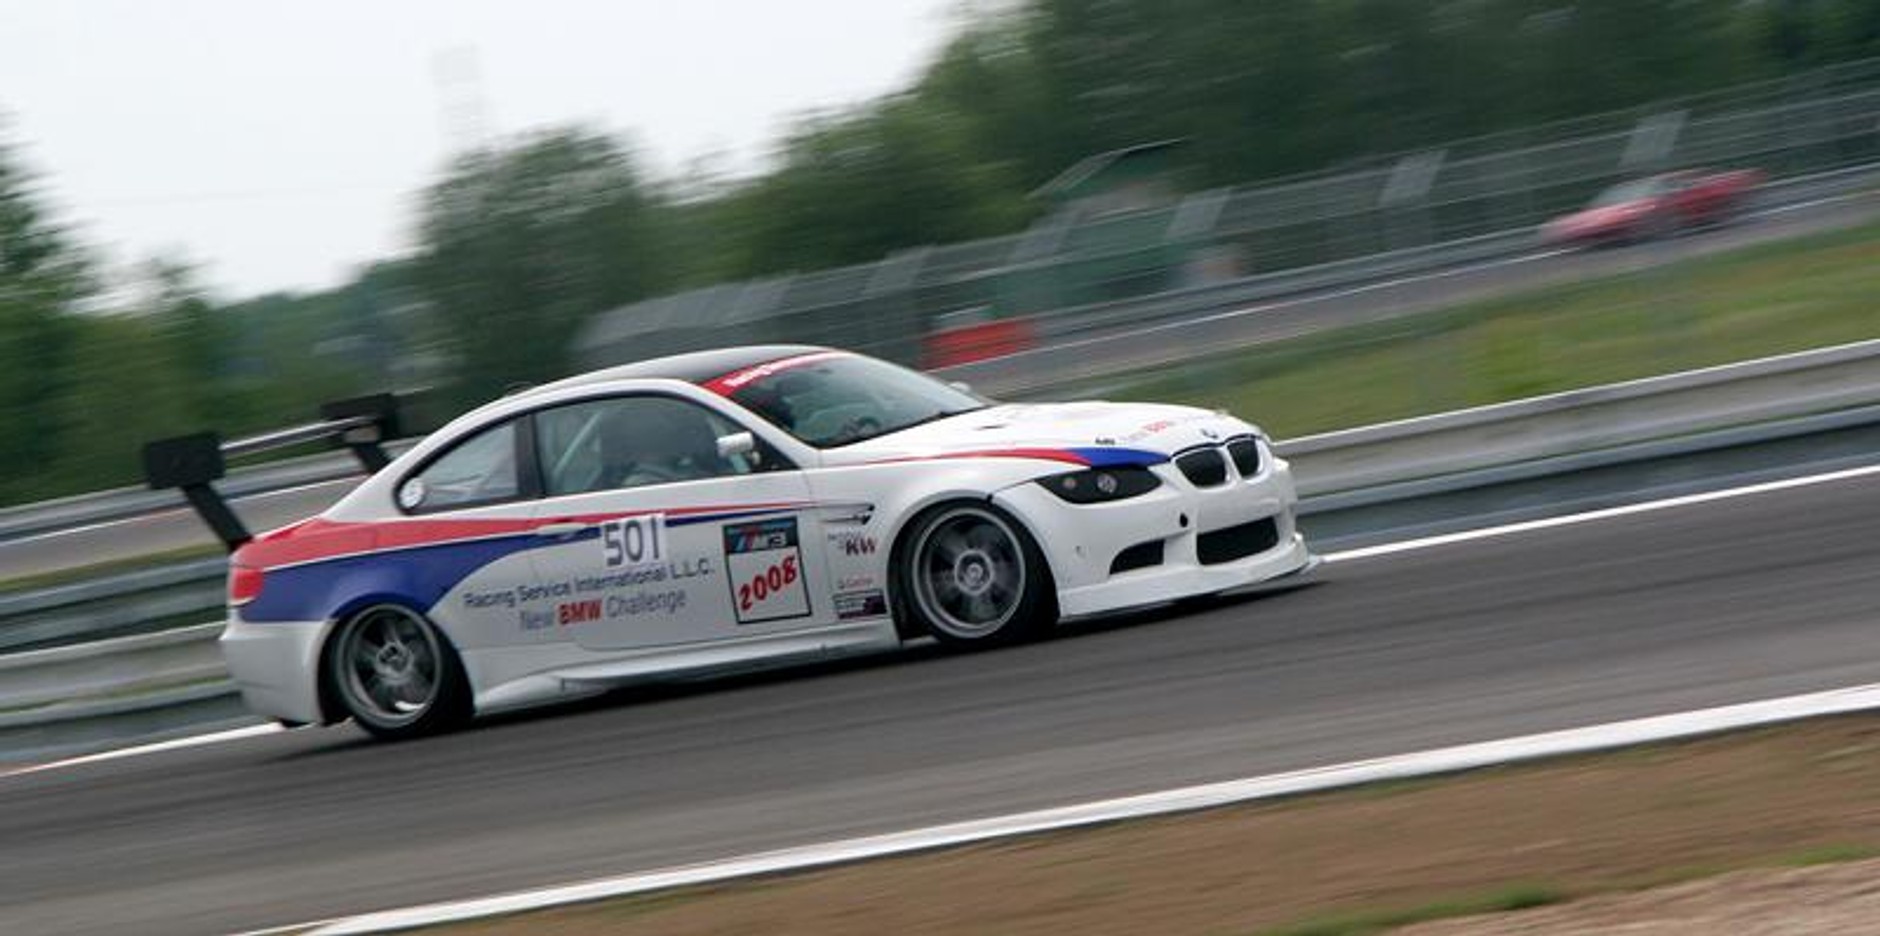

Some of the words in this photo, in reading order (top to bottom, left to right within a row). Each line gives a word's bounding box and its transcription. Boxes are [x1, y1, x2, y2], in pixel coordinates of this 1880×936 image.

[604, 517, 660, 567] 501
[846, 537, 875, 556] KW
[463, 590, 516, 608] Racing
[517, 583, 571, 602] Service
[574, 568, 668, 593] International
[738, 554, 798, 611] 2008
[559, 600, 602, 626] BMW
[605, 589, 686, 618] Challenge
